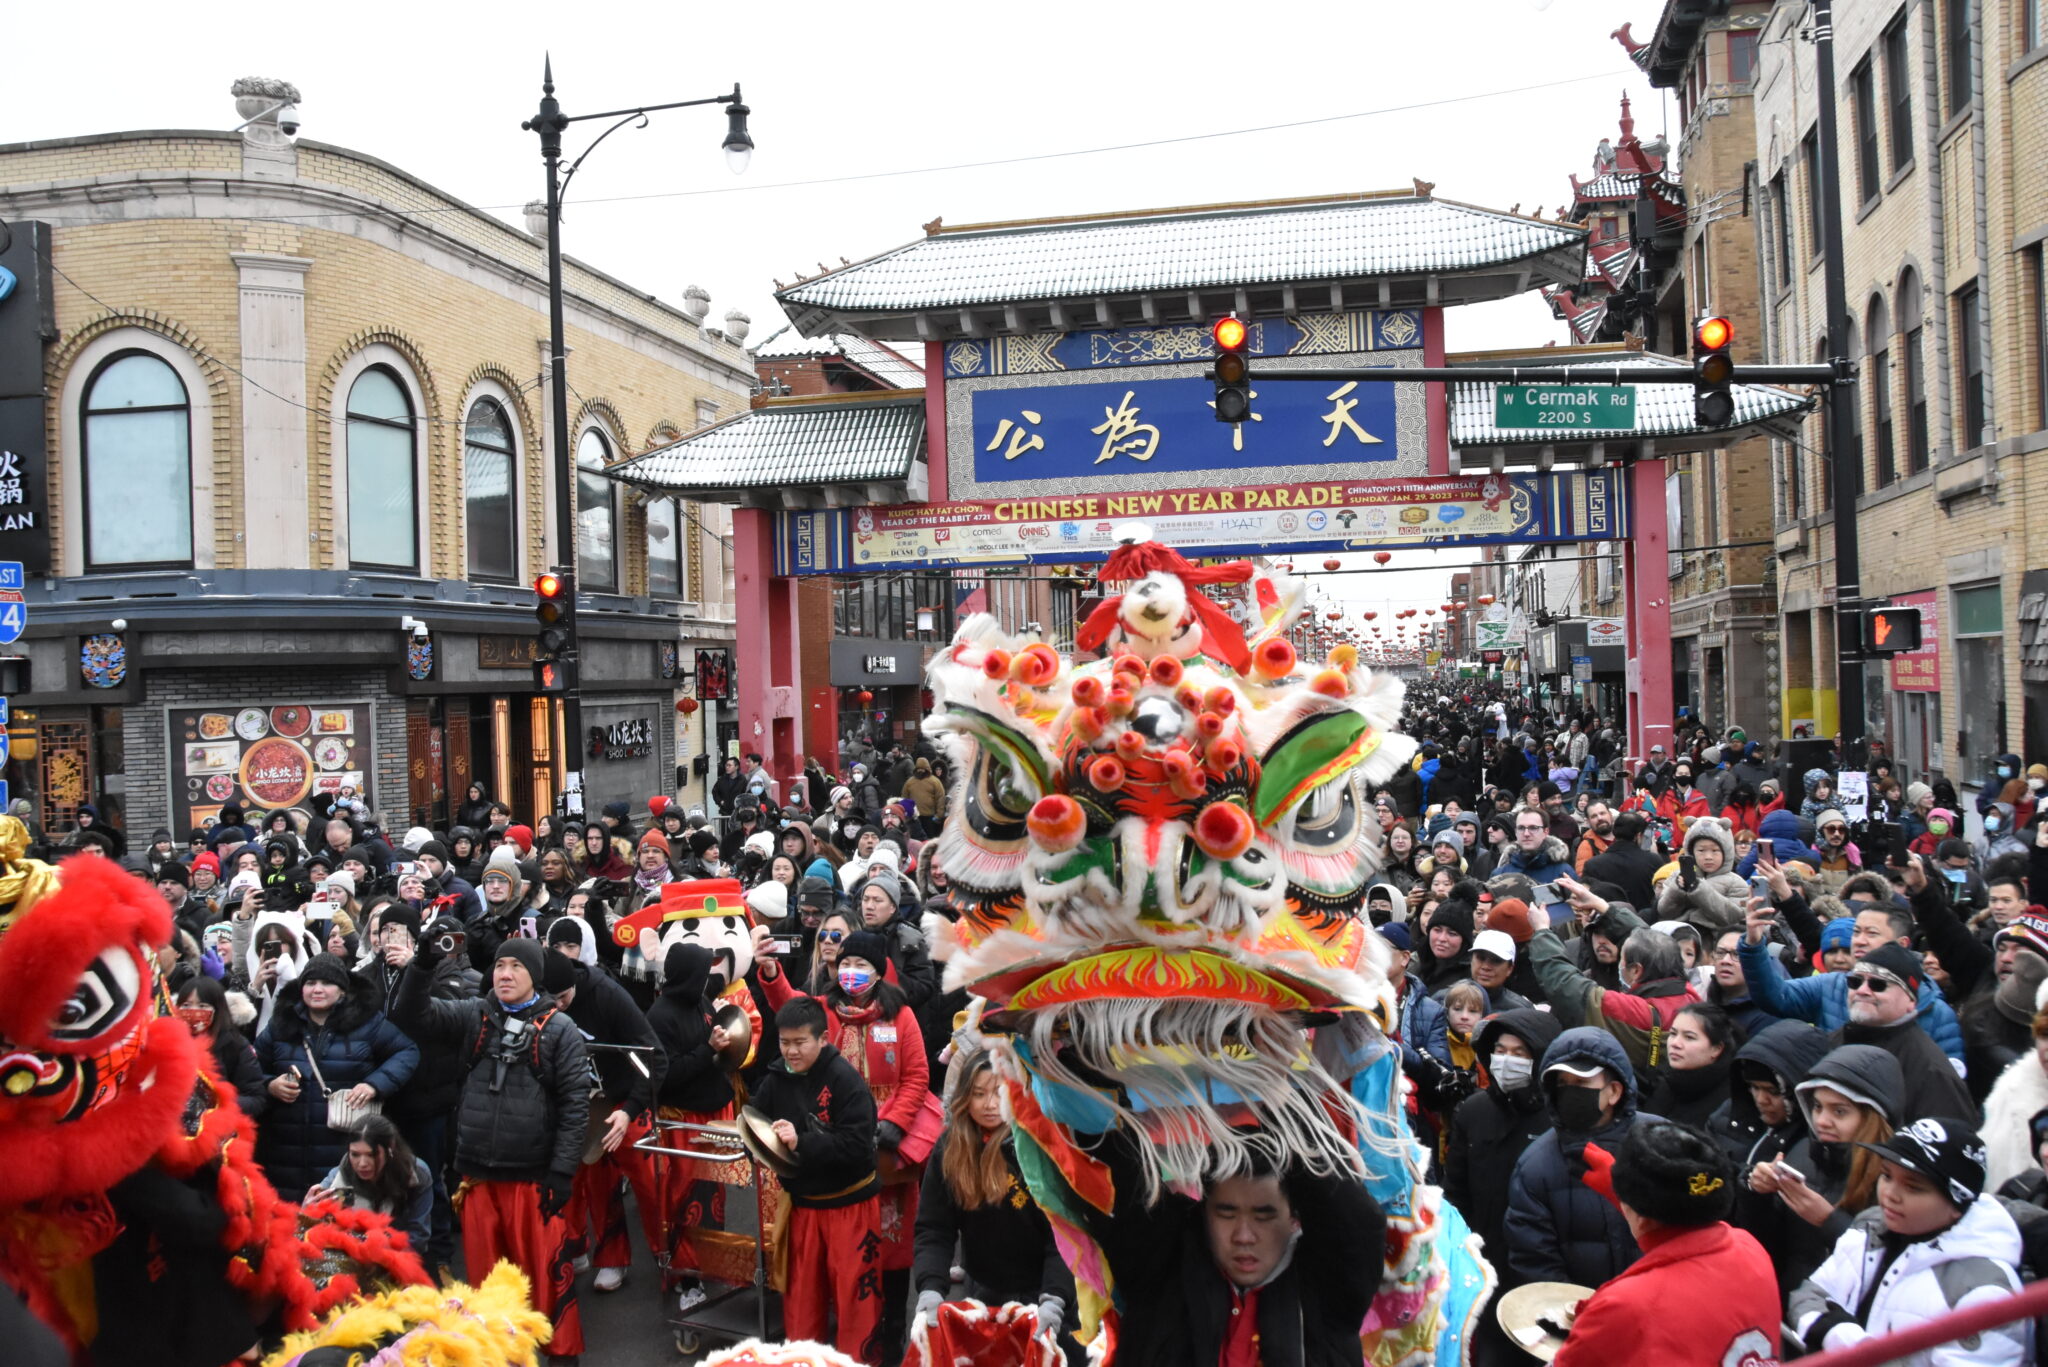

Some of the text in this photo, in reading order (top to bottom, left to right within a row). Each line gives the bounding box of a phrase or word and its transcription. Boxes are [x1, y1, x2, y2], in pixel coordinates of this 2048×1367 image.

[1503, 389, 1628, 406] W Cermak Rd
[1538, 412, 1591, 424] 2200 S
[1348, 486, 1401, 494] CHINATOWN'S
[1425, 482, 1478, 491] ANNIVERSARY
[994, 487, 1343, 521] CHINESE NEW YEAR PARADE
[1392, 494, 1414, 502] JAN.
[888, 505, 983, 518] KUNG HAY FAT CHOY!
[881, 513, 991, 527] YEAR OF THE RABBIT 4721
[1221, 517, 1264, 530] HYATT
[957, 579, 984, 589] TOWN
[608, 748, 623, 759] SHOO
